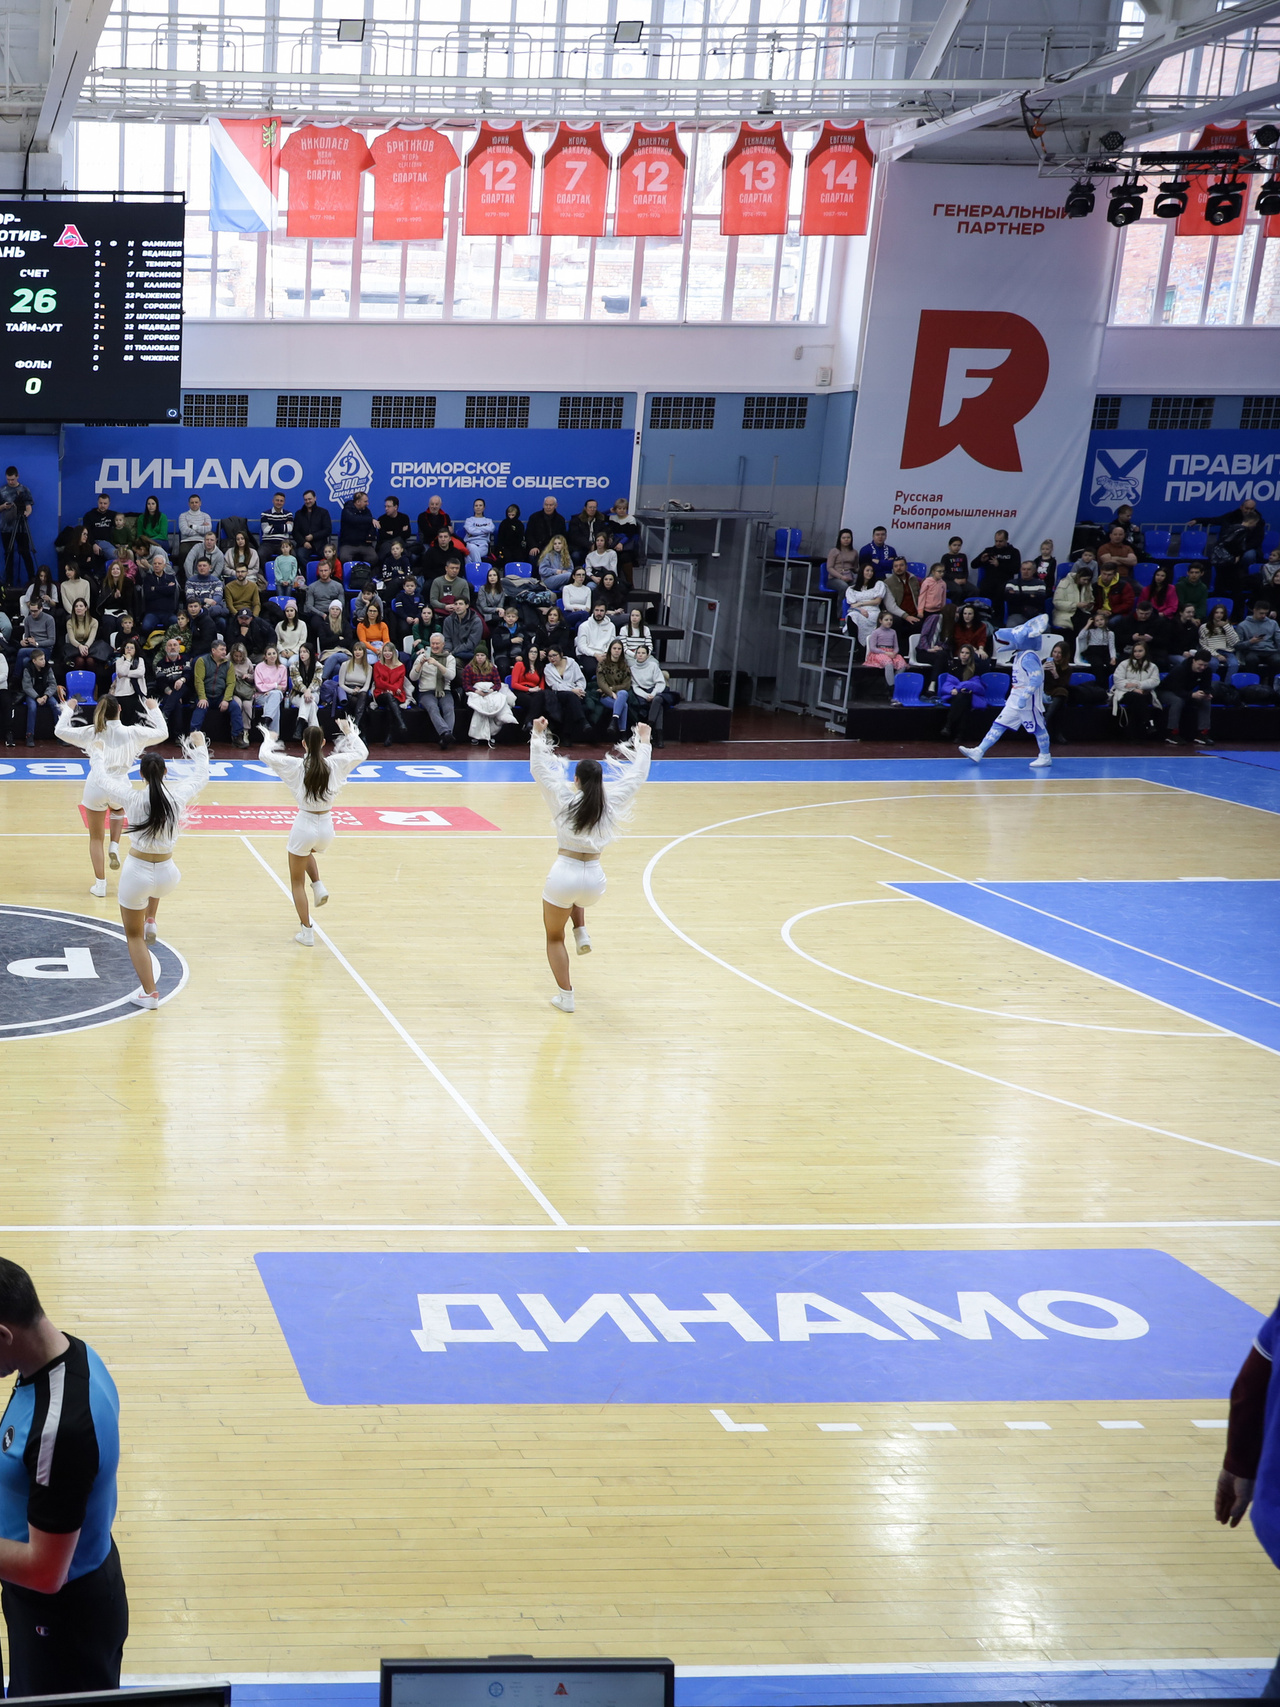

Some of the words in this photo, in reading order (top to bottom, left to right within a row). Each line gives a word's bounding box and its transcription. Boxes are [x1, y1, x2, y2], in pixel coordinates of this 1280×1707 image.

[301, 137, 350, 150] НИКОЛАЕВ
[387, 140, 434, 154] БРИТИКОВ
[306, 170, 342, 181] СПАРТАК
[392, 172, 428, 183] СПАРТАК
[480, 160, 517, 191] 12
[565, 161, 588, 191] 7
[632, 161, 669, 192] 12
[739, 160, 776, 191] 13
[821, 159, 858, 191] 14
[481, 193, 515, 204] СПАРТАК
[556, 193, 591, 205] СПАРТАК
[632, 194, 667, 205] СПАРТАК
[739, 193, 773, 204] СПАРТАК
[820, 193, 854, 204] СПАРТАК
[956, 220, 1046, 236] ПАРТНЕР
[19, 269, 49, 278] СЧЕТ
[9, 288, 57, 313] 26
[143, 302, 181, 310] СОРОКИН
[6, 322, 63, 333] ТАЙМ-АУТ
[143, 333, 180, 341] КОРОБКО
[15, 360, 52, 369] ФОЛЫ
[24, 377, 42, 394] 0
[390, 461, 510, 475] ПРИМОРСКОЕ
[94, 457, 303, 494] ДИНАМО
[390, 475, 508, 489] СПОРТИВНОЕ
[512, 475, 610, 491] ОБЩЕСТВО
[333, 486, 366, 498] ДИНАМО
[895, 490, 943, 504] Русская
[893, 504, 1017, 519] Рыбопромышленная
[891, 518, 951, 531] Компания
[410, 1289, 1150, 1352] ДИНАМО
